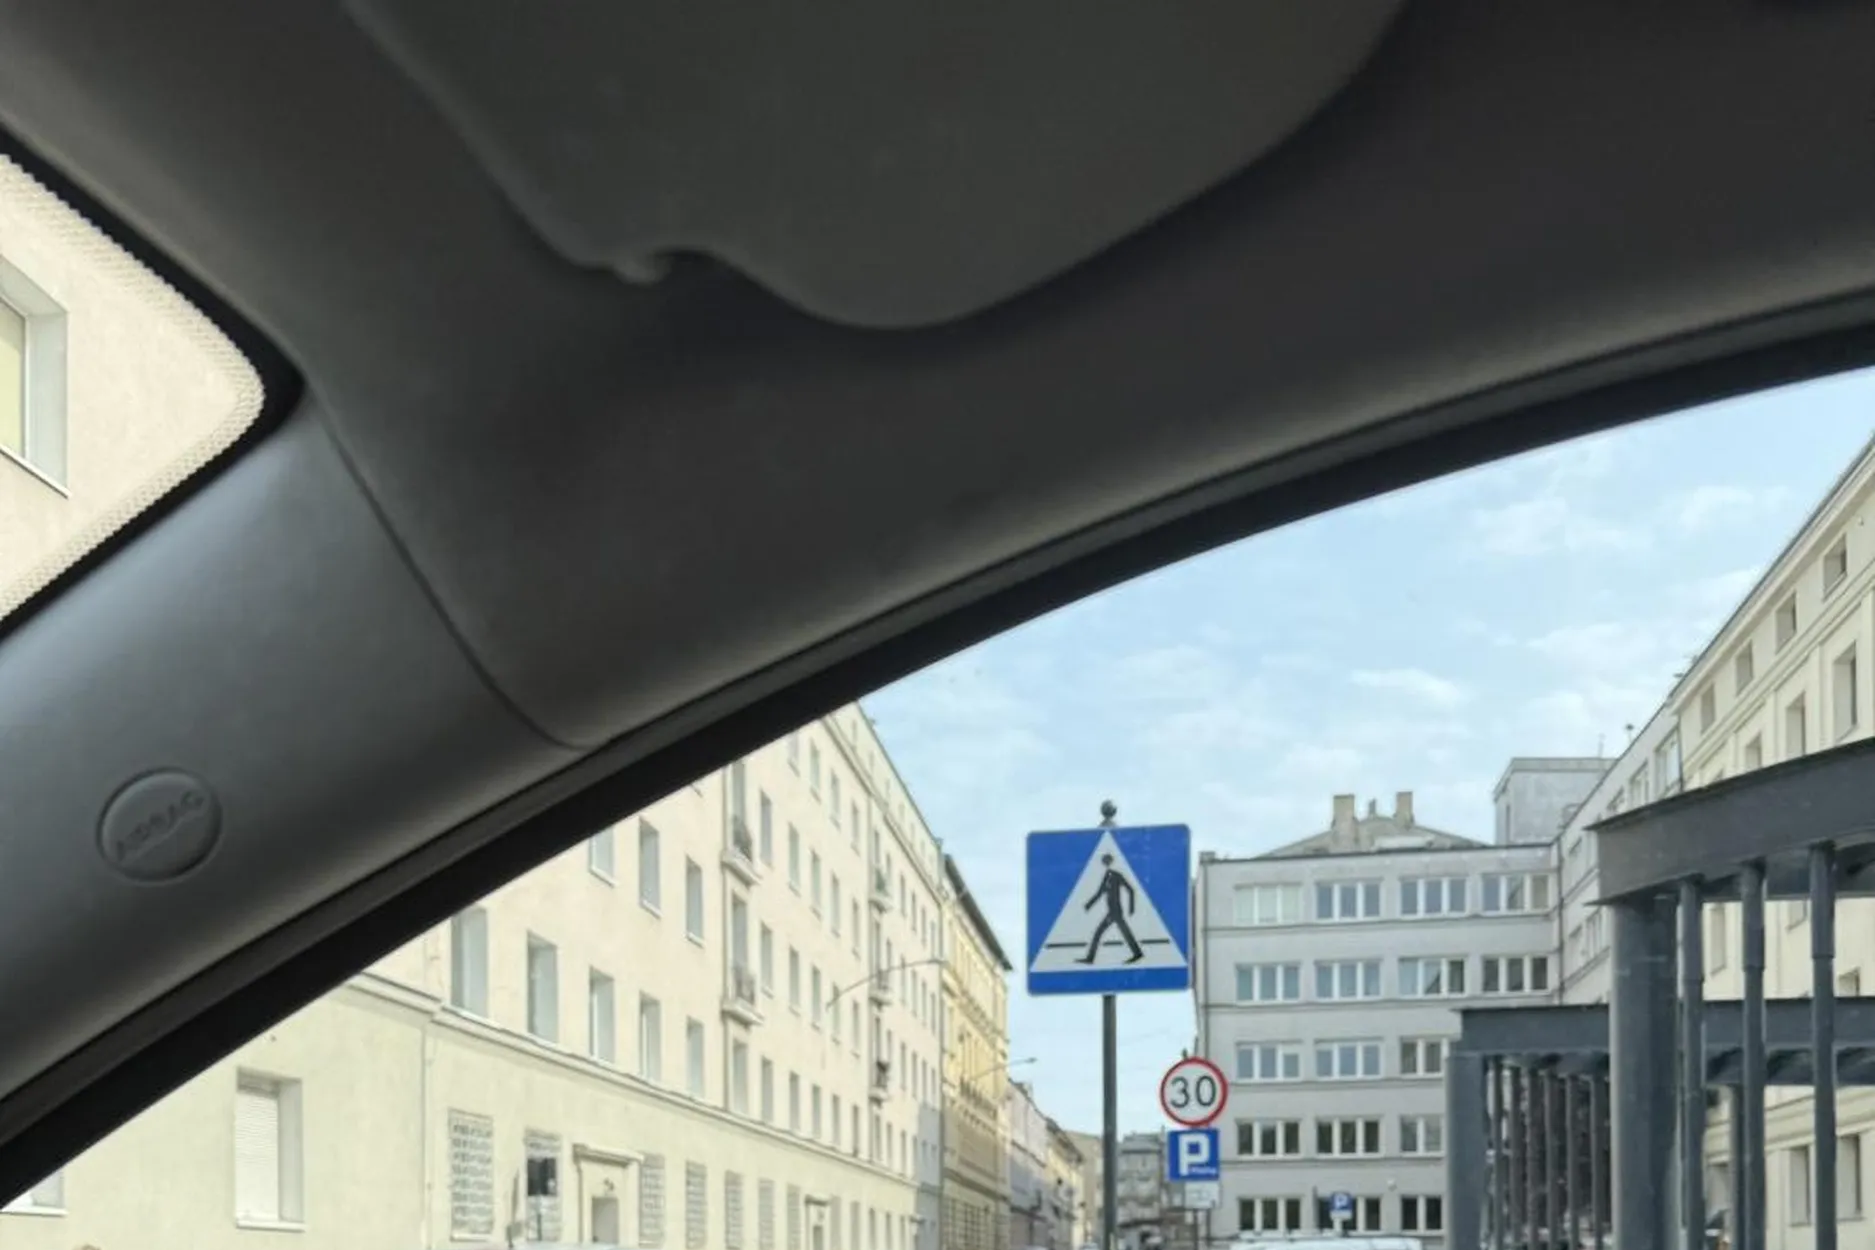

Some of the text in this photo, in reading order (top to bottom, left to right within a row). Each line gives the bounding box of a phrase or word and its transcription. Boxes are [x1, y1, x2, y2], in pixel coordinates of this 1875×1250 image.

[1171, 1075, 1216, 1109] 30
[1178, 1133, 1210, 1176] P
[1334, 1193, 1348, 1209] P
